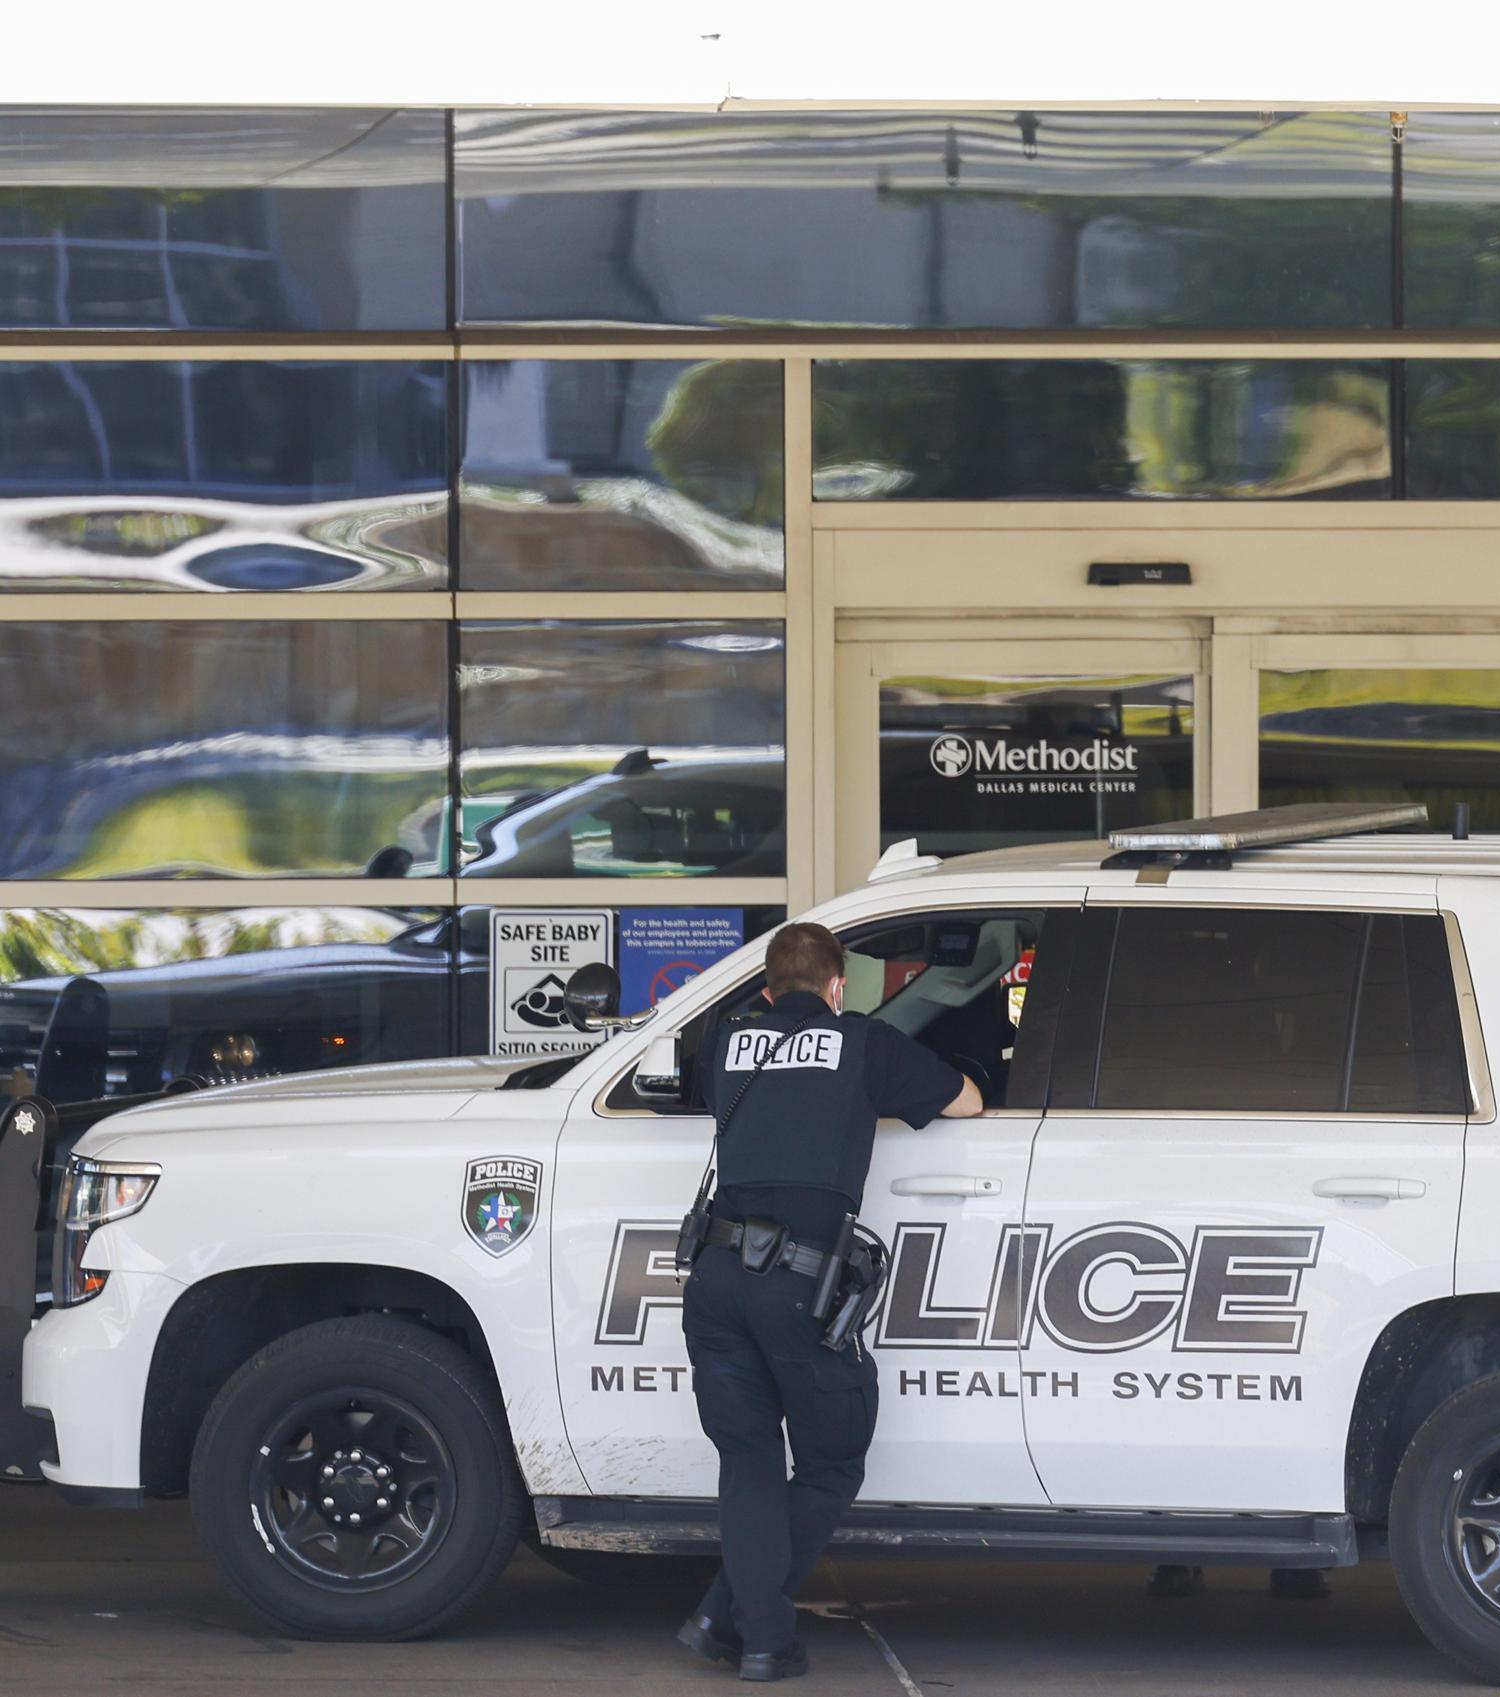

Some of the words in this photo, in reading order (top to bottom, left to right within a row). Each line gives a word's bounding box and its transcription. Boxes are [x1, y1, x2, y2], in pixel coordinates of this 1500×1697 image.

[975, 739, 1138, 772] Methodist
[976, 782, 1025, 793] DALLAS
[1029, 782, 1084, 793] MEDICAL
[1089, 782, 1136, 793] CENTER
[500, 924, 546, 942] SAFE
[552, 924, 601, 942] BABY
[633, 919, 647, 928] For
[648, 919, 661, 928] the
[663, 919, 688, 928] health
[689, 919, 704, 928] and
[706, 919, 731, 929] safety
[622, 929, 631, 938] of
[632, 929, 646, 938] our
[647, 929, 690, 939] employees
[692, 929, 707, 938] and
[530, 945, 570, 962] SITE
[498, 1042, 536, 1055] SITIO
[734, 1034, 832, 1065] POLICE
[474, 1162, 534, 1181] POLICE
[594, 1218, 1325, 1354] PLICE
[900, 1370, 1079, 1397] HEALTH
[1112, 1372, 1304, 1401] SYSTEM
